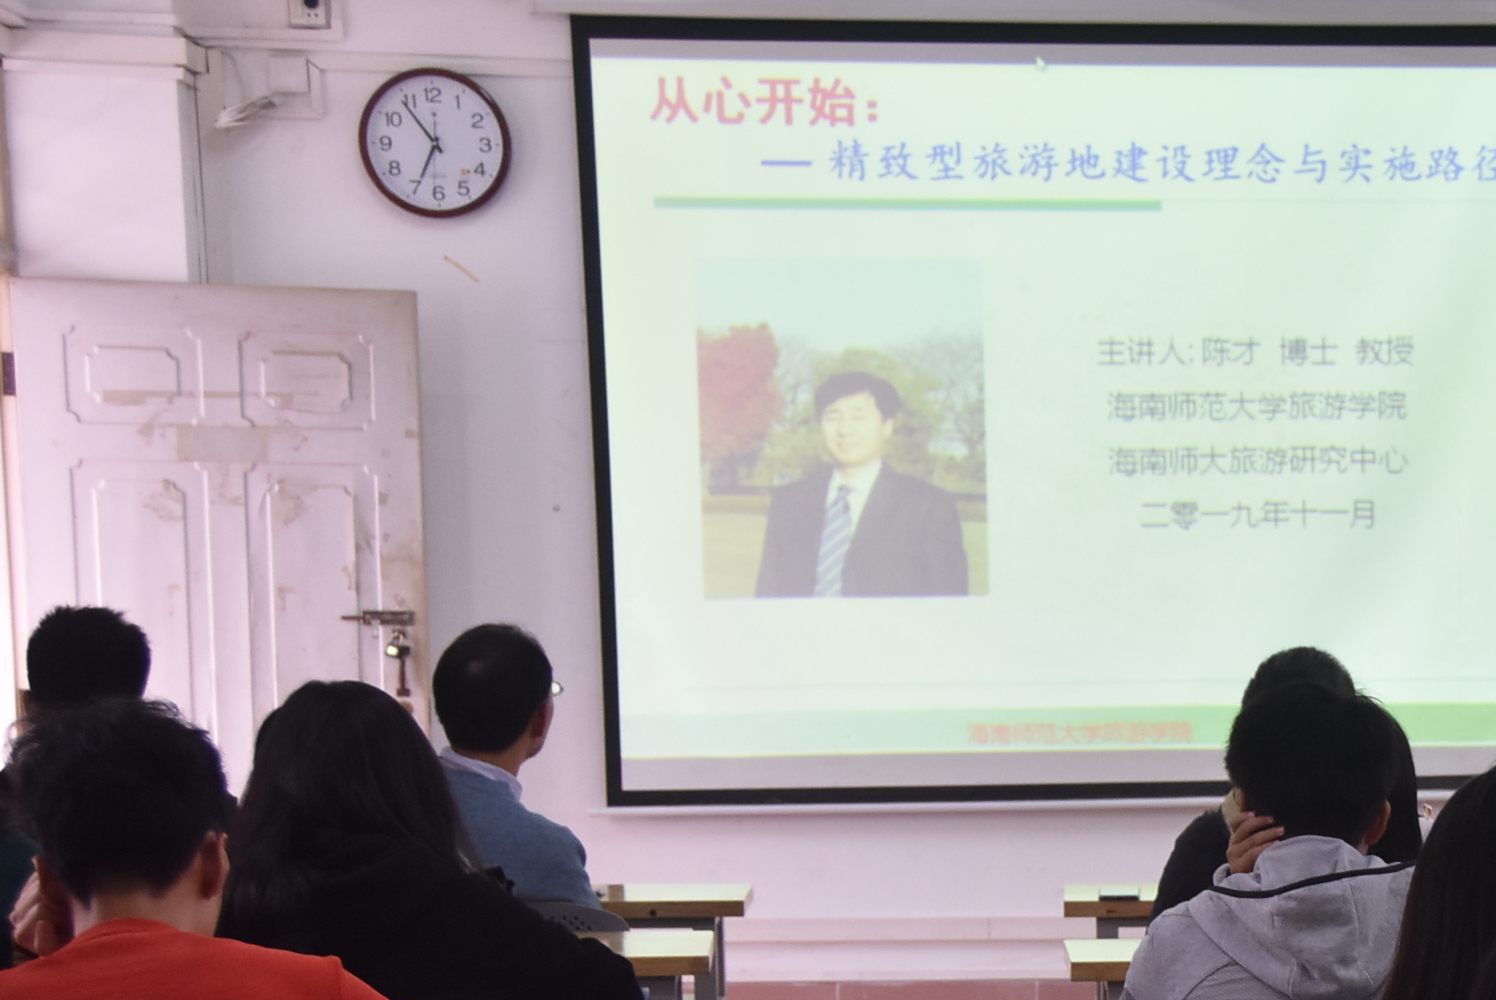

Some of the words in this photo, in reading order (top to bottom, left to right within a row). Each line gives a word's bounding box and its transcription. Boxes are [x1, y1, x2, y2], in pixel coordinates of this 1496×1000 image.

[403, 94, 417, 109] 11
[424, 87, 442, 103] 12
[455, 95, 461, 110] 1
[650, 75, 878, 126] 从心开始：
[385, 111, 402, 127] 10
[471, 112, 484, 129] 2
[379, 135, 392, 151] 9
[479, 137, 492, 153] 3
[388, 160, 401, 176] 8
[473, 162, 485, 177] 4
[409, 180, 422, 195] 7
[432, 185, 445, 201] 6
[457, 181, 470, 196] 5
[1280, 336, 1338, 367] 博士
[1355, 336, 1415, 367] 教授
[1107, 391, 1407, 422] 海南师范大学旅游学院
[1108, 445, 1409, 477] 海南师大旅游研究中心
[1140, 499, 1376, 530] 二零一九年十一月
